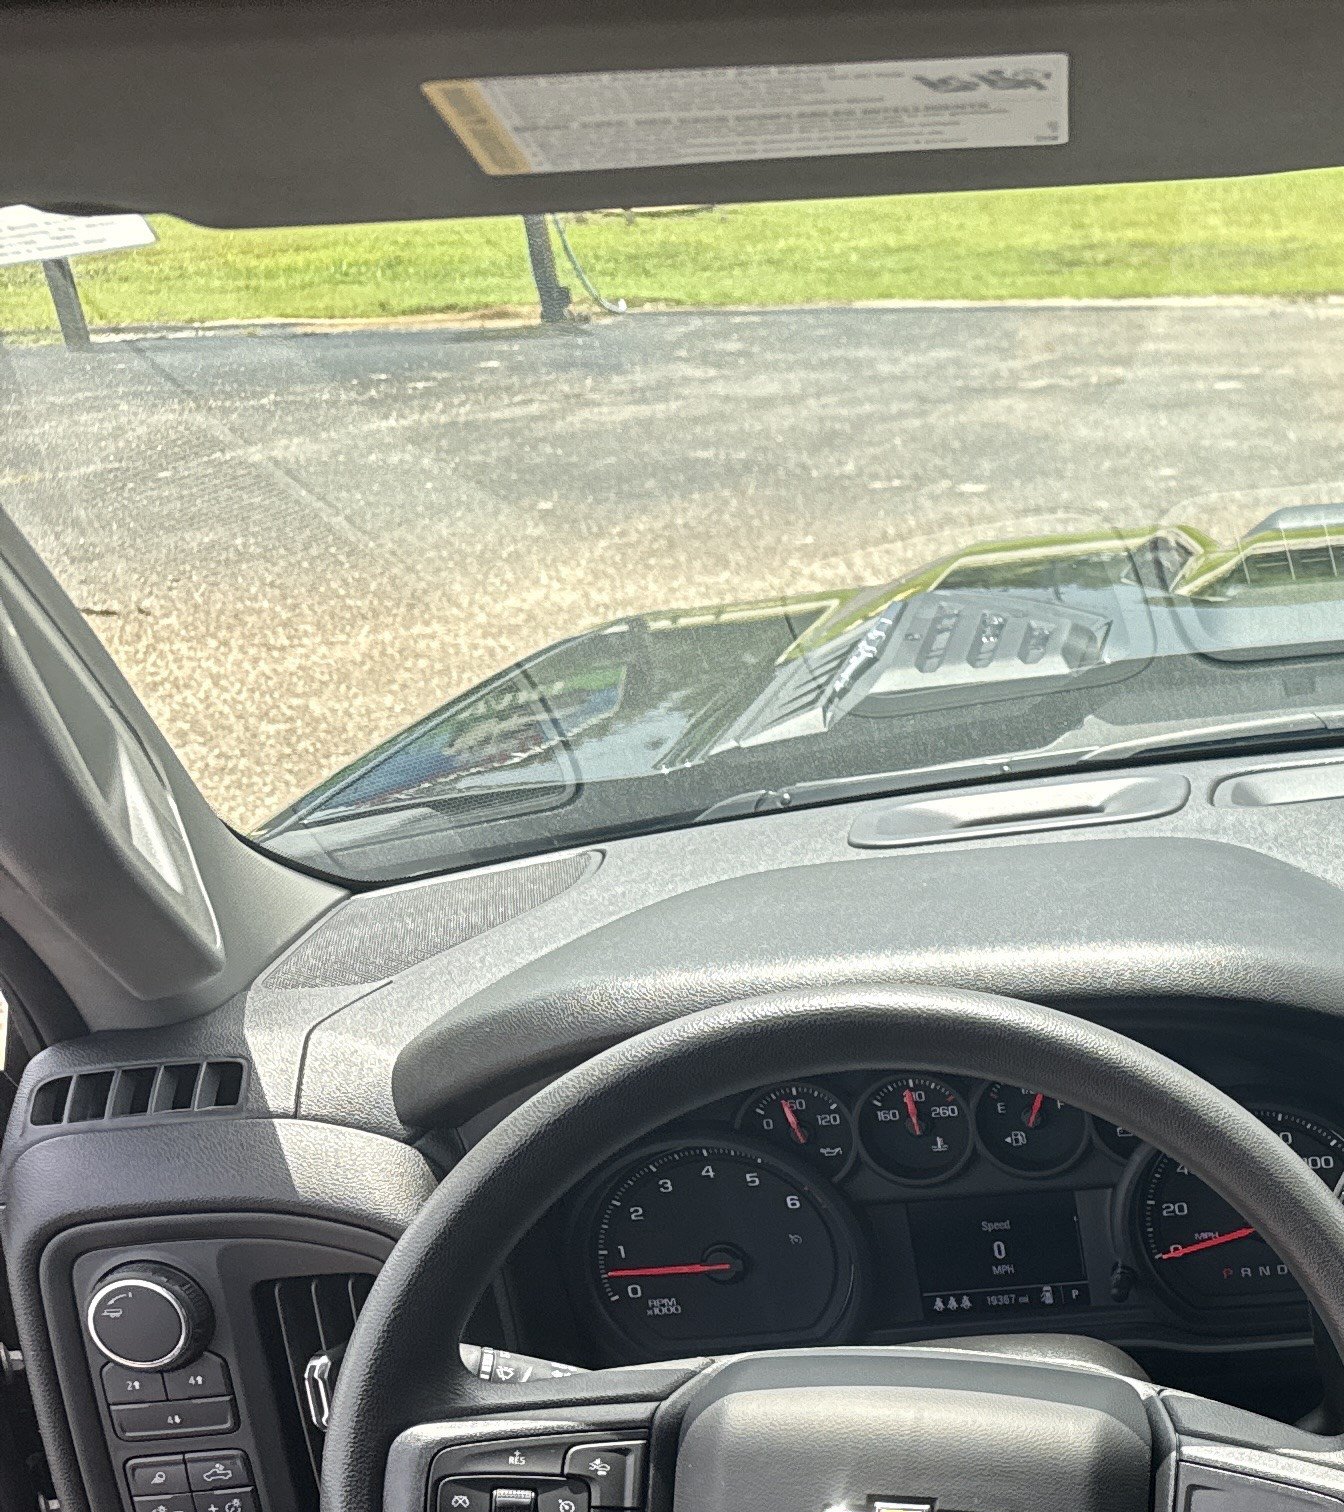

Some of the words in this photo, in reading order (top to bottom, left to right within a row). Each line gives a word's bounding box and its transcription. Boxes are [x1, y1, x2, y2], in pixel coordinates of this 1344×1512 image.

[877, 1109, 900, 1122] 160
[930, 1105, 959, 1118] 260
[763, 1118, 774, 1130] 0
[816, 1113, 841, 1126] 120
[701, 1165, 716, 1179] 4
[658, 1179, 673, 1193] 3
[745, 1173, 760, 1187] 5
[786, 1195, 801, 1209] 6
[1162, 1202, 1188, 1216] 20
[629, 1206, 645, 1221] 2
[981, 1220, 1011, 1232] Speed
[617, 1245, 626, 1259] 1
[993, 1241, 1007, 1259] 0
[992, 1264, 1015, 1275] MPH
[1240, 1267, 1252, 1277] R
[1259, 1266, 1271, 1276] N
[1277, 1264, 1289, 1275] D
[627, 1284, 642, 1299] 0
[508, 1456, 526, 1466] RES
